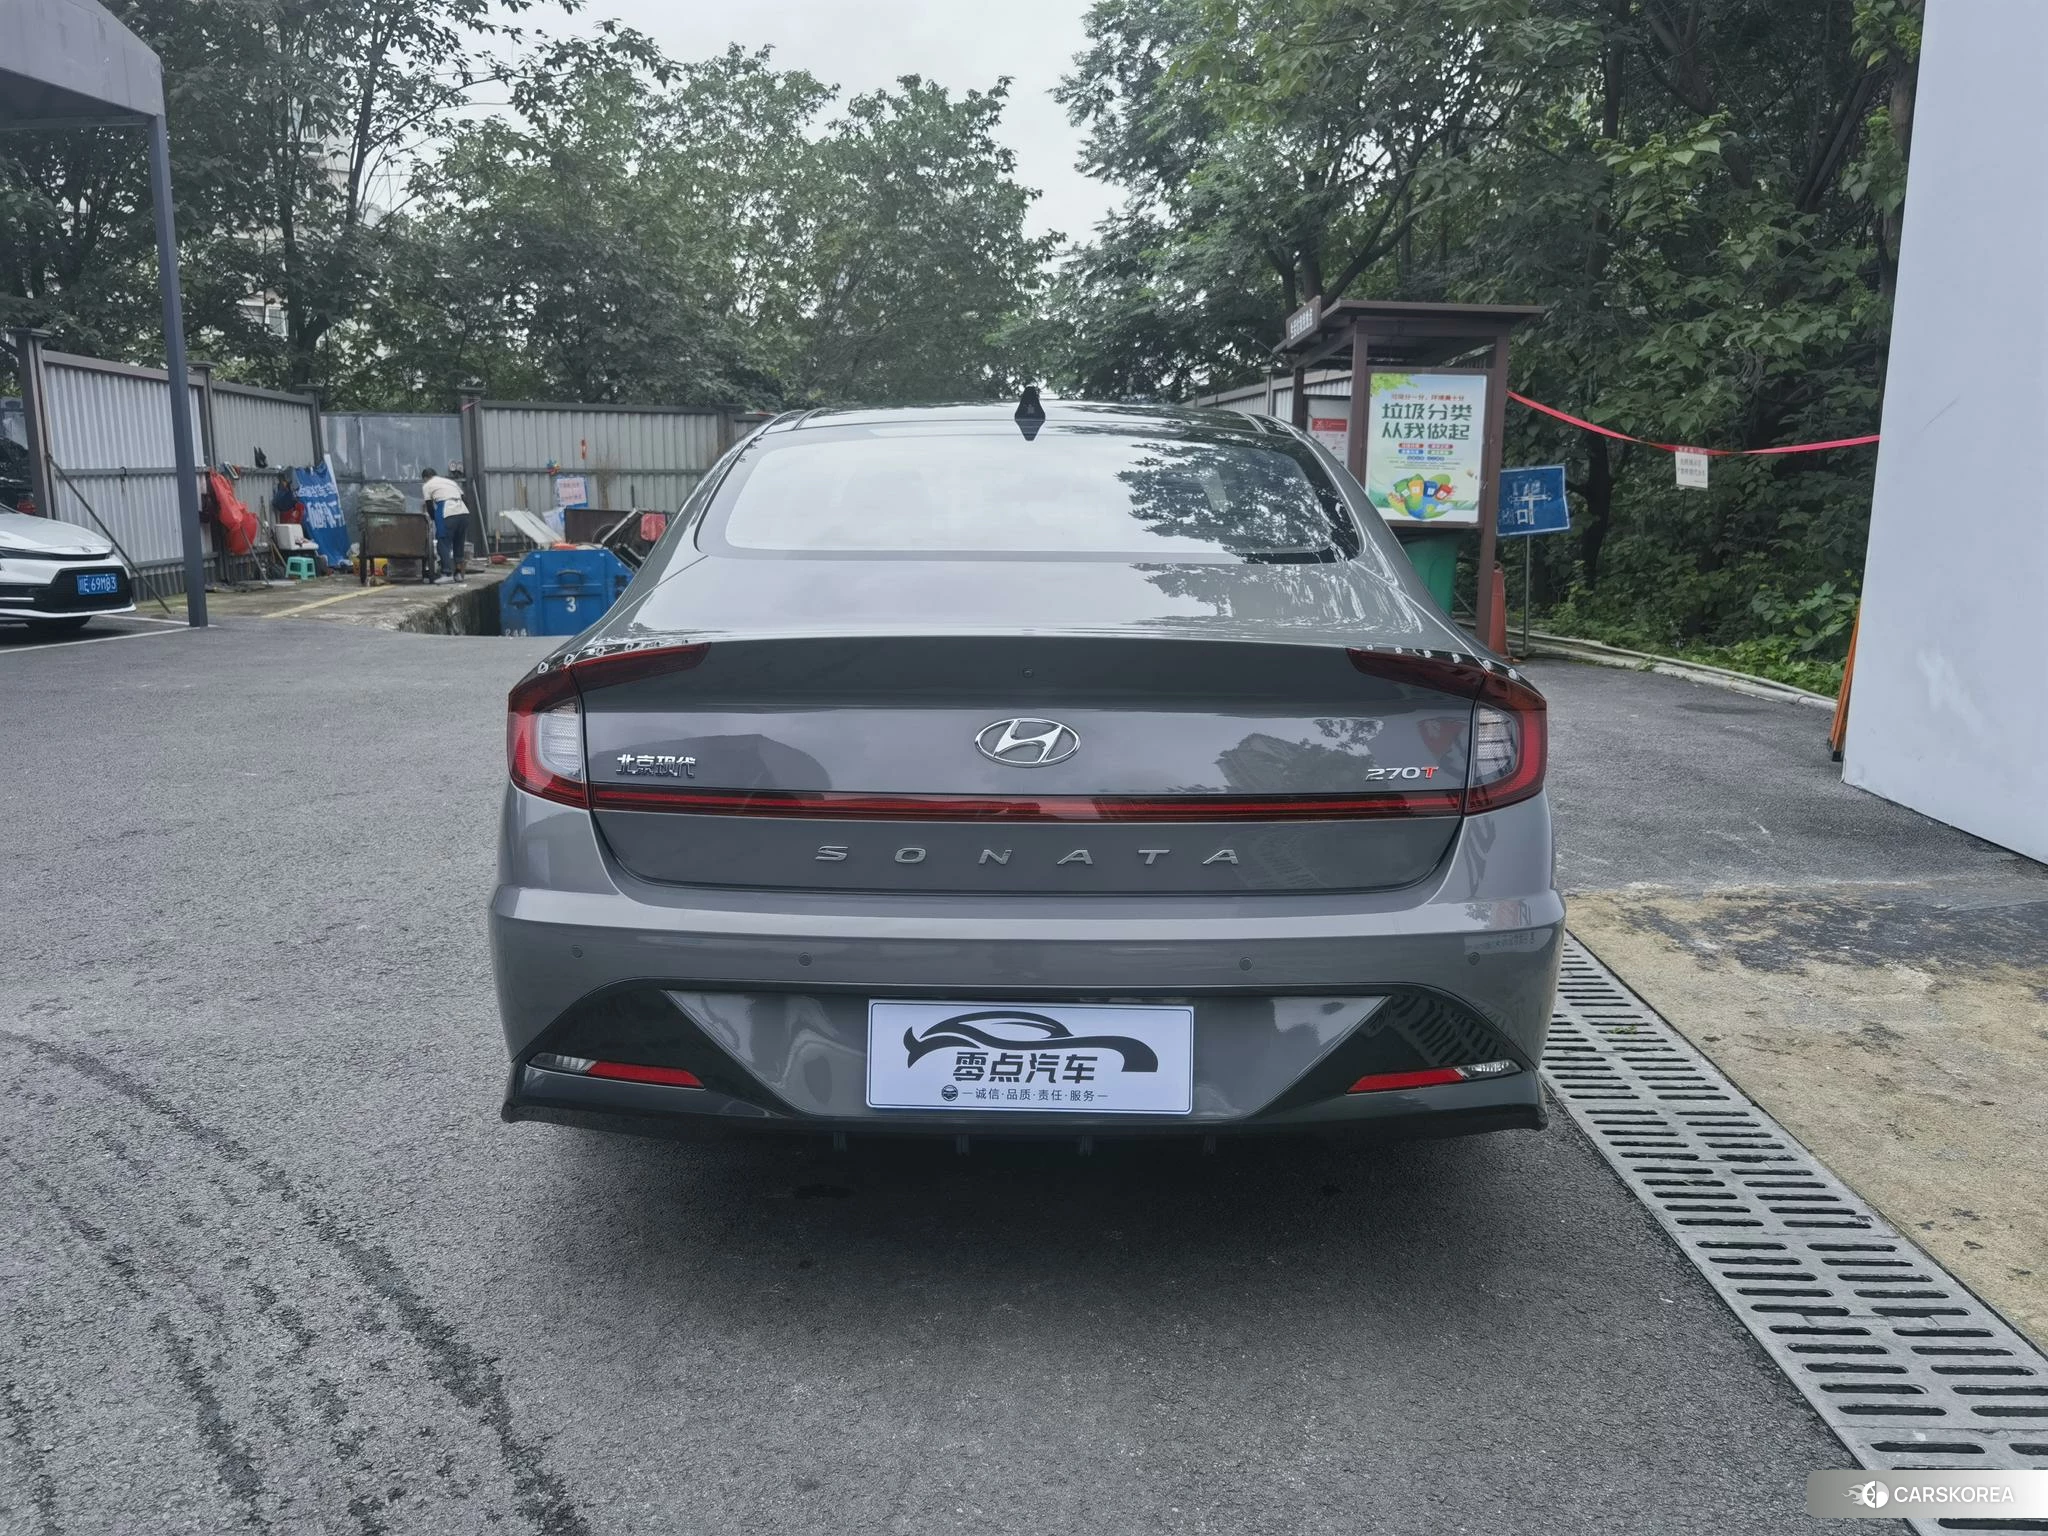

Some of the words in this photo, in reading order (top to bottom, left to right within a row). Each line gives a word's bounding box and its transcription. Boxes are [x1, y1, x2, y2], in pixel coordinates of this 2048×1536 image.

[1382, 403, 1472, 421] 垃圾分类
[1382, 422, 1470, 440] 从我做起
[566, 596, 577, 612] 3
[616, 754, 696, 777] 北京现代
[1365, 766, 1439, 780] 270T
[815, 845, 1239, 865] SONATA
[953, 1051, 1099, 1084] 零点汽车
